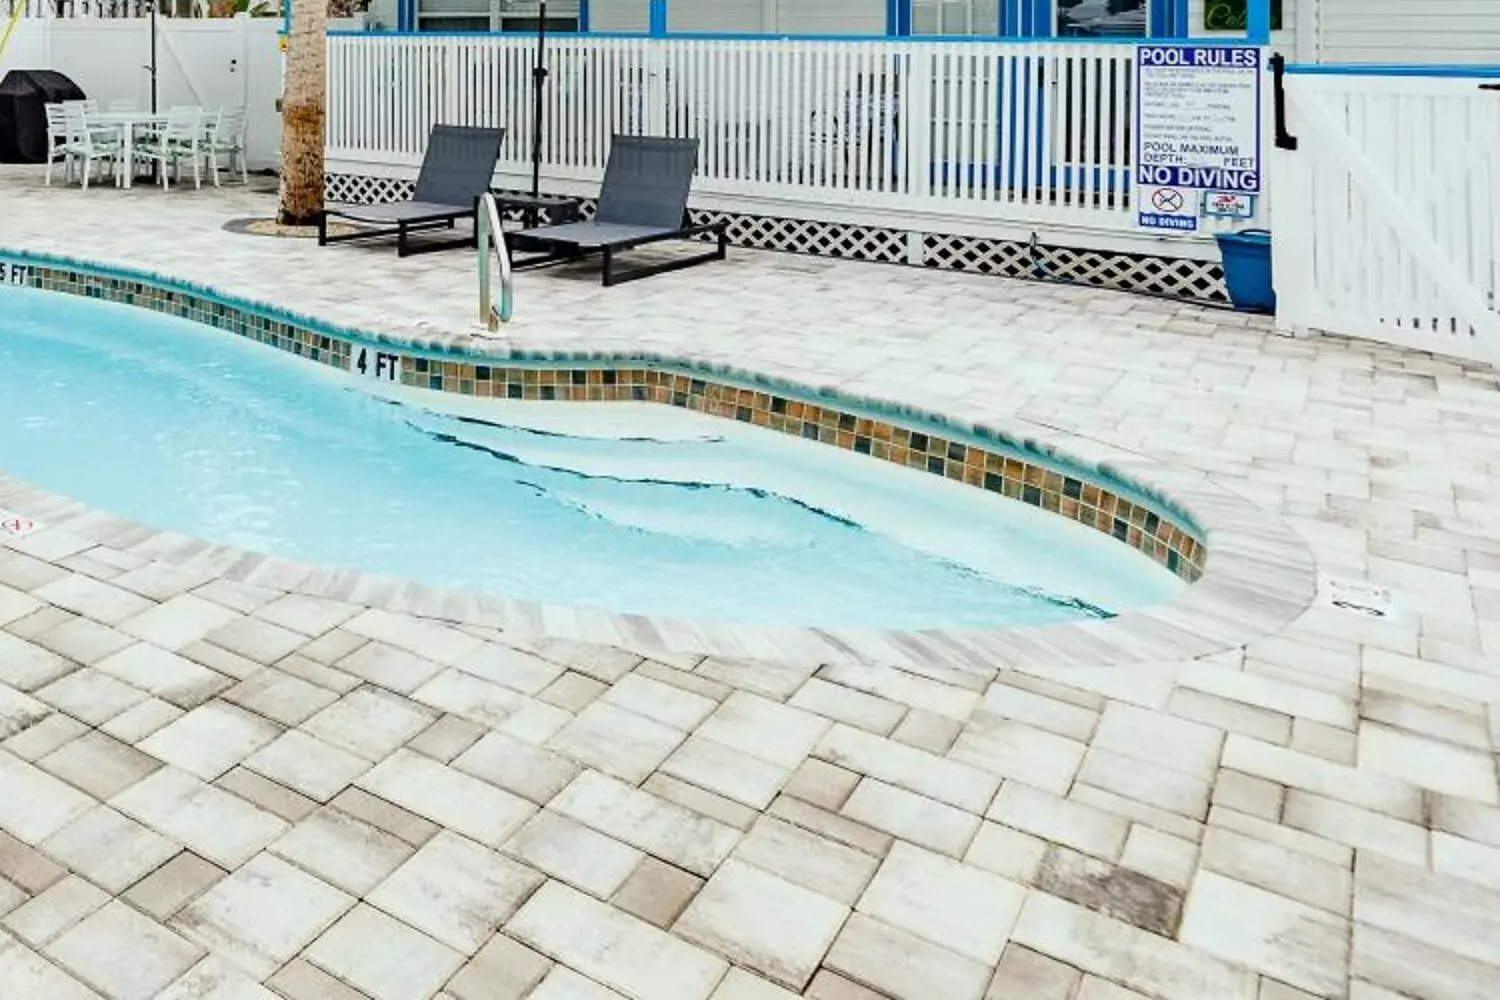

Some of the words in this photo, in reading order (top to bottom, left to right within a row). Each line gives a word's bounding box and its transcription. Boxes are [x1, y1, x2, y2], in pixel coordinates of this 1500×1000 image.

[1140, 48, 1190, 65] POOL
[1194, 49, 1257, 67] RULES
[1143, 141, 1176, 153] POOL
[1180, 143, 1239, 156] MAXIMUM
[1143, 153, 1187, 164] DEPTH:
[1223, 157, 1254, 167] FEET
[1139, 165, 1171, 184] NO
[1178, 167, 1257, 189] DIVING
[1141, 215, 1157, 225] NO
[0, 262, 6, 281] 5
[11, 264, 27, 285] FT
[357, 348, 367, 375] 4
[376, 351, 399, 381] FT
